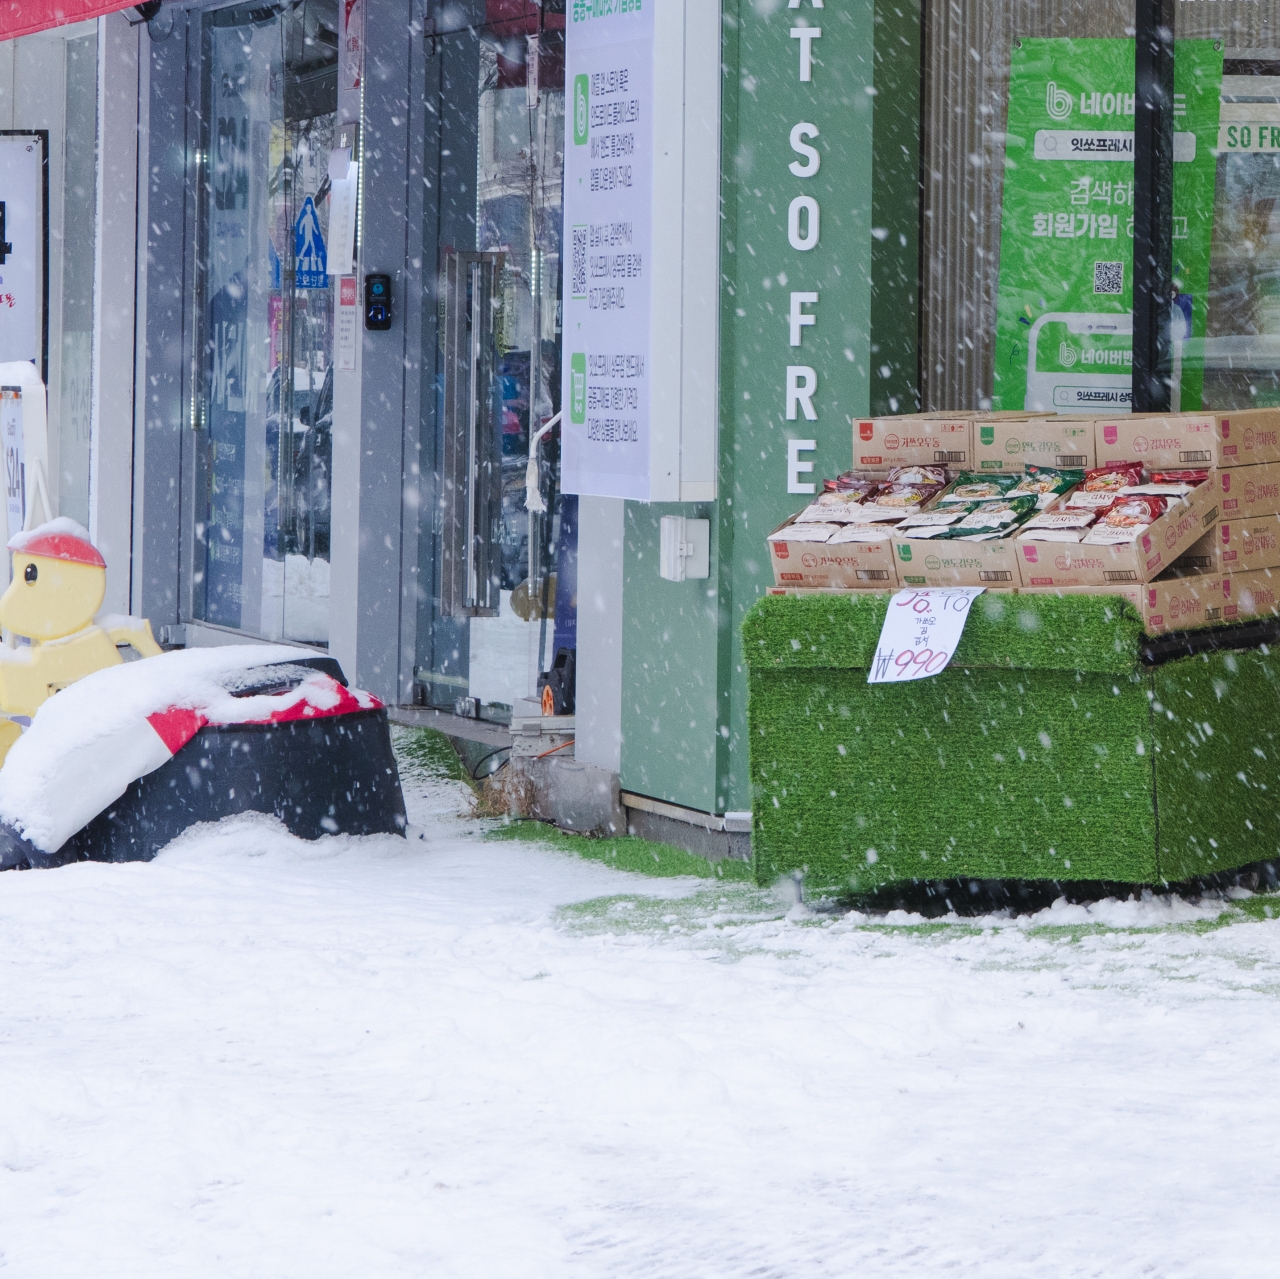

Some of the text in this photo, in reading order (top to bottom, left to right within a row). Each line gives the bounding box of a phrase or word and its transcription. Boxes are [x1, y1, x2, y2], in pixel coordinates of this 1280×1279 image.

[1227, 125, 1251, 148] SO
[1071, 138, 1132, 153] 잇쏘프레시
[788, 122, 821, 251] SO
[1032, 212, 1118, 239] 회원가입
[1077, 391, 1118, 402] 잇쏘프레시
[902, 436, 940, 448] 가쓰오우동
[1021, 440, 1061, 452] 완도김우동
[1150, 437, 1182, 450] 김치우동
[820, 556, 860, 568] 가쓰오우동
[942, 557, 983, 569] 완도김우동
[1072, 558, 1105, 570] 김치우동
